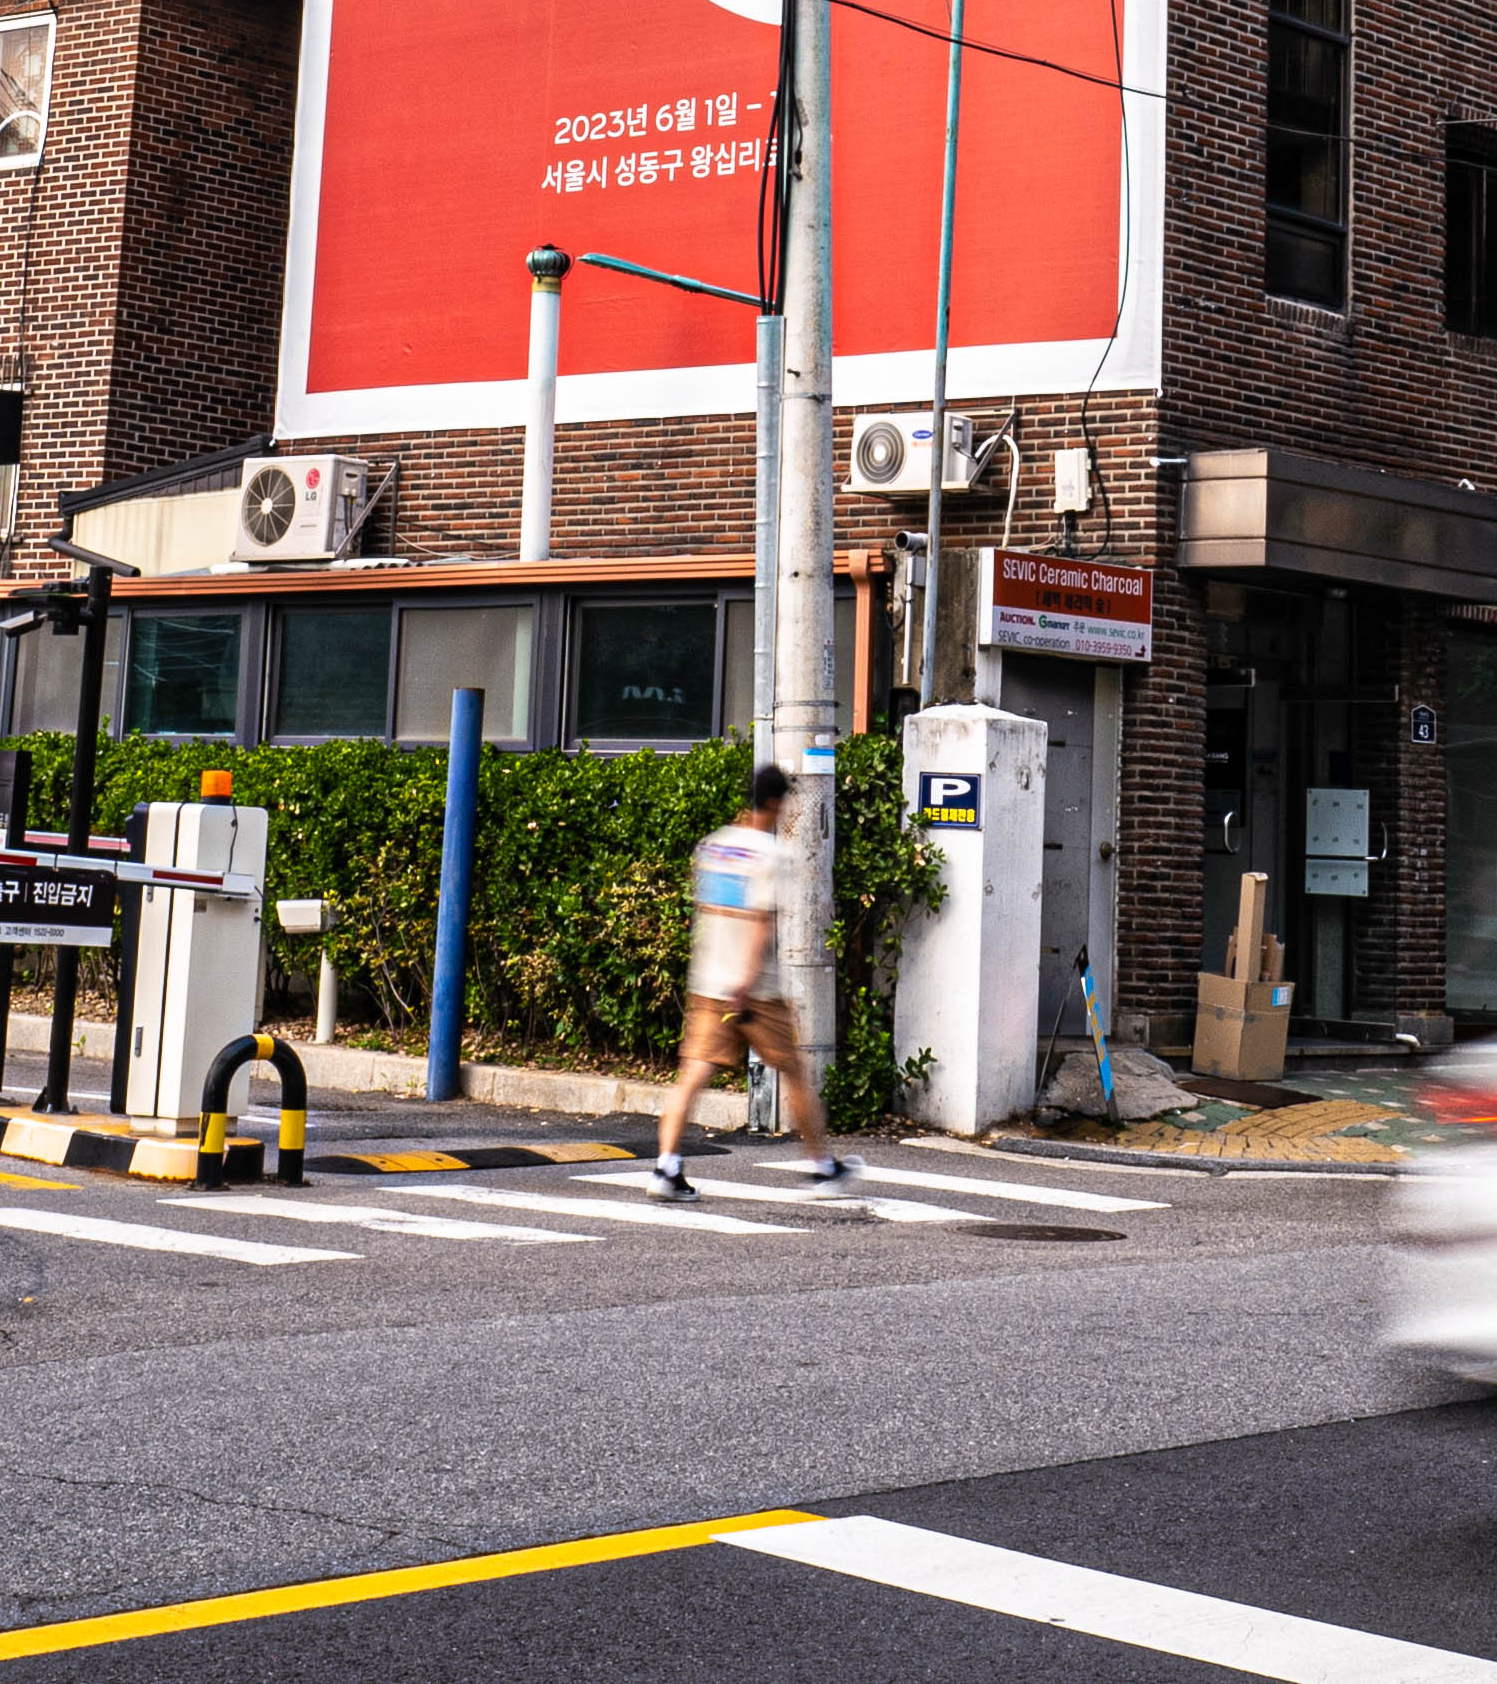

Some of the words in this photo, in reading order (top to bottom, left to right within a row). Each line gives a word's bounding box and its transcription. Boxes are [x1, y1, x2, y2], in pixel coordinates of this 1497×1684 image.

[554, 103, 648, 145] 2023년
[655, 97, 696, 132] 6월
[704, 92, 737, 126] 1일
[541, 156, 607, 194] 서울시
[614, 148, 684, 187] 성동구
[306, 492, 317, 501] LG
[1003, 558, 1036, 582] SEVIC
[1039, 563, 1088, 589] Ceramic
[1091, 570, 1143, 596] Charcoal
[1087, 625, 1145, 641] www.sevic.co.kr
[1418, 724, 1430, 739] 43
[931, 778, 971, 805] P
[33, 881, 93, 908] 진입금지
